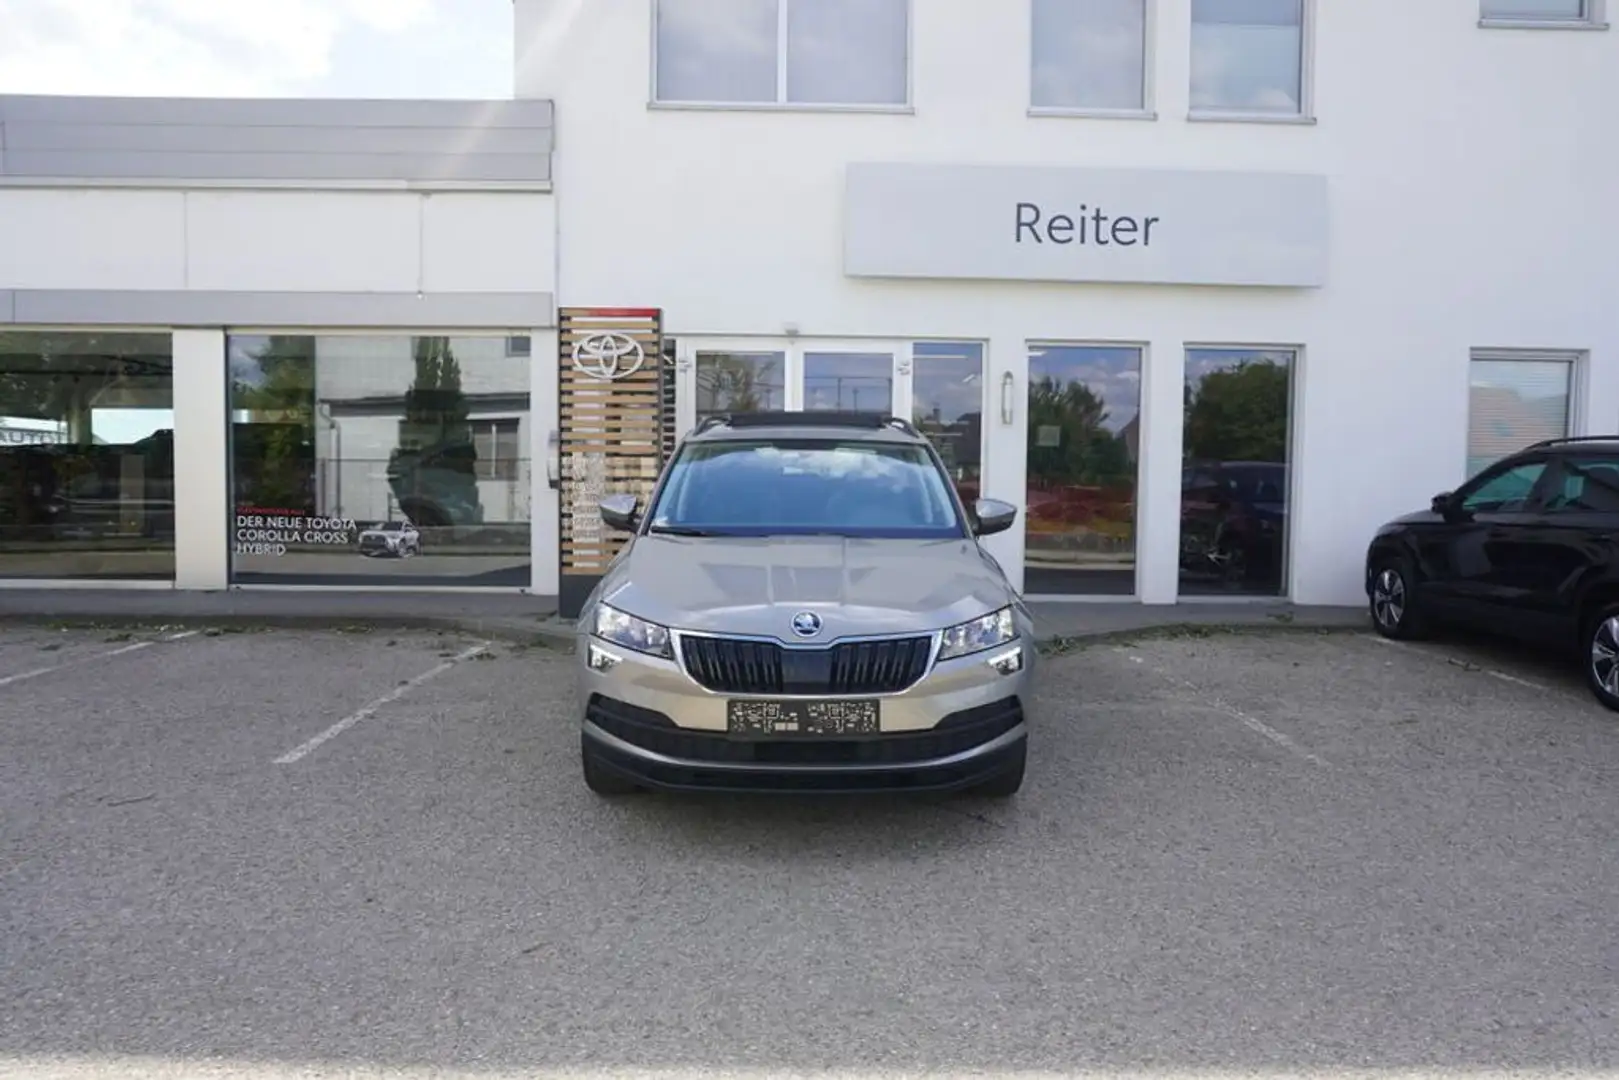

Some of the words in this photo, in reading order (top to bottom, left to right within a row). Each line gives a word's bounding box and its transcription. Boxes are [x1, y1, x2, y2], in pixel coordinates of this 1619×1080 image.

[1015, 202, 1160, 247] Reiter
[237, 516, 263, 528] DER
[267, 516, 302, 529] NEUE
[305, 517, 357, 530] TOYOTA
[237, 529, 301, 542] COROLLA
[303, 530, 349, 544] CROSS
[237, 543, 286, 556] HYBRID
